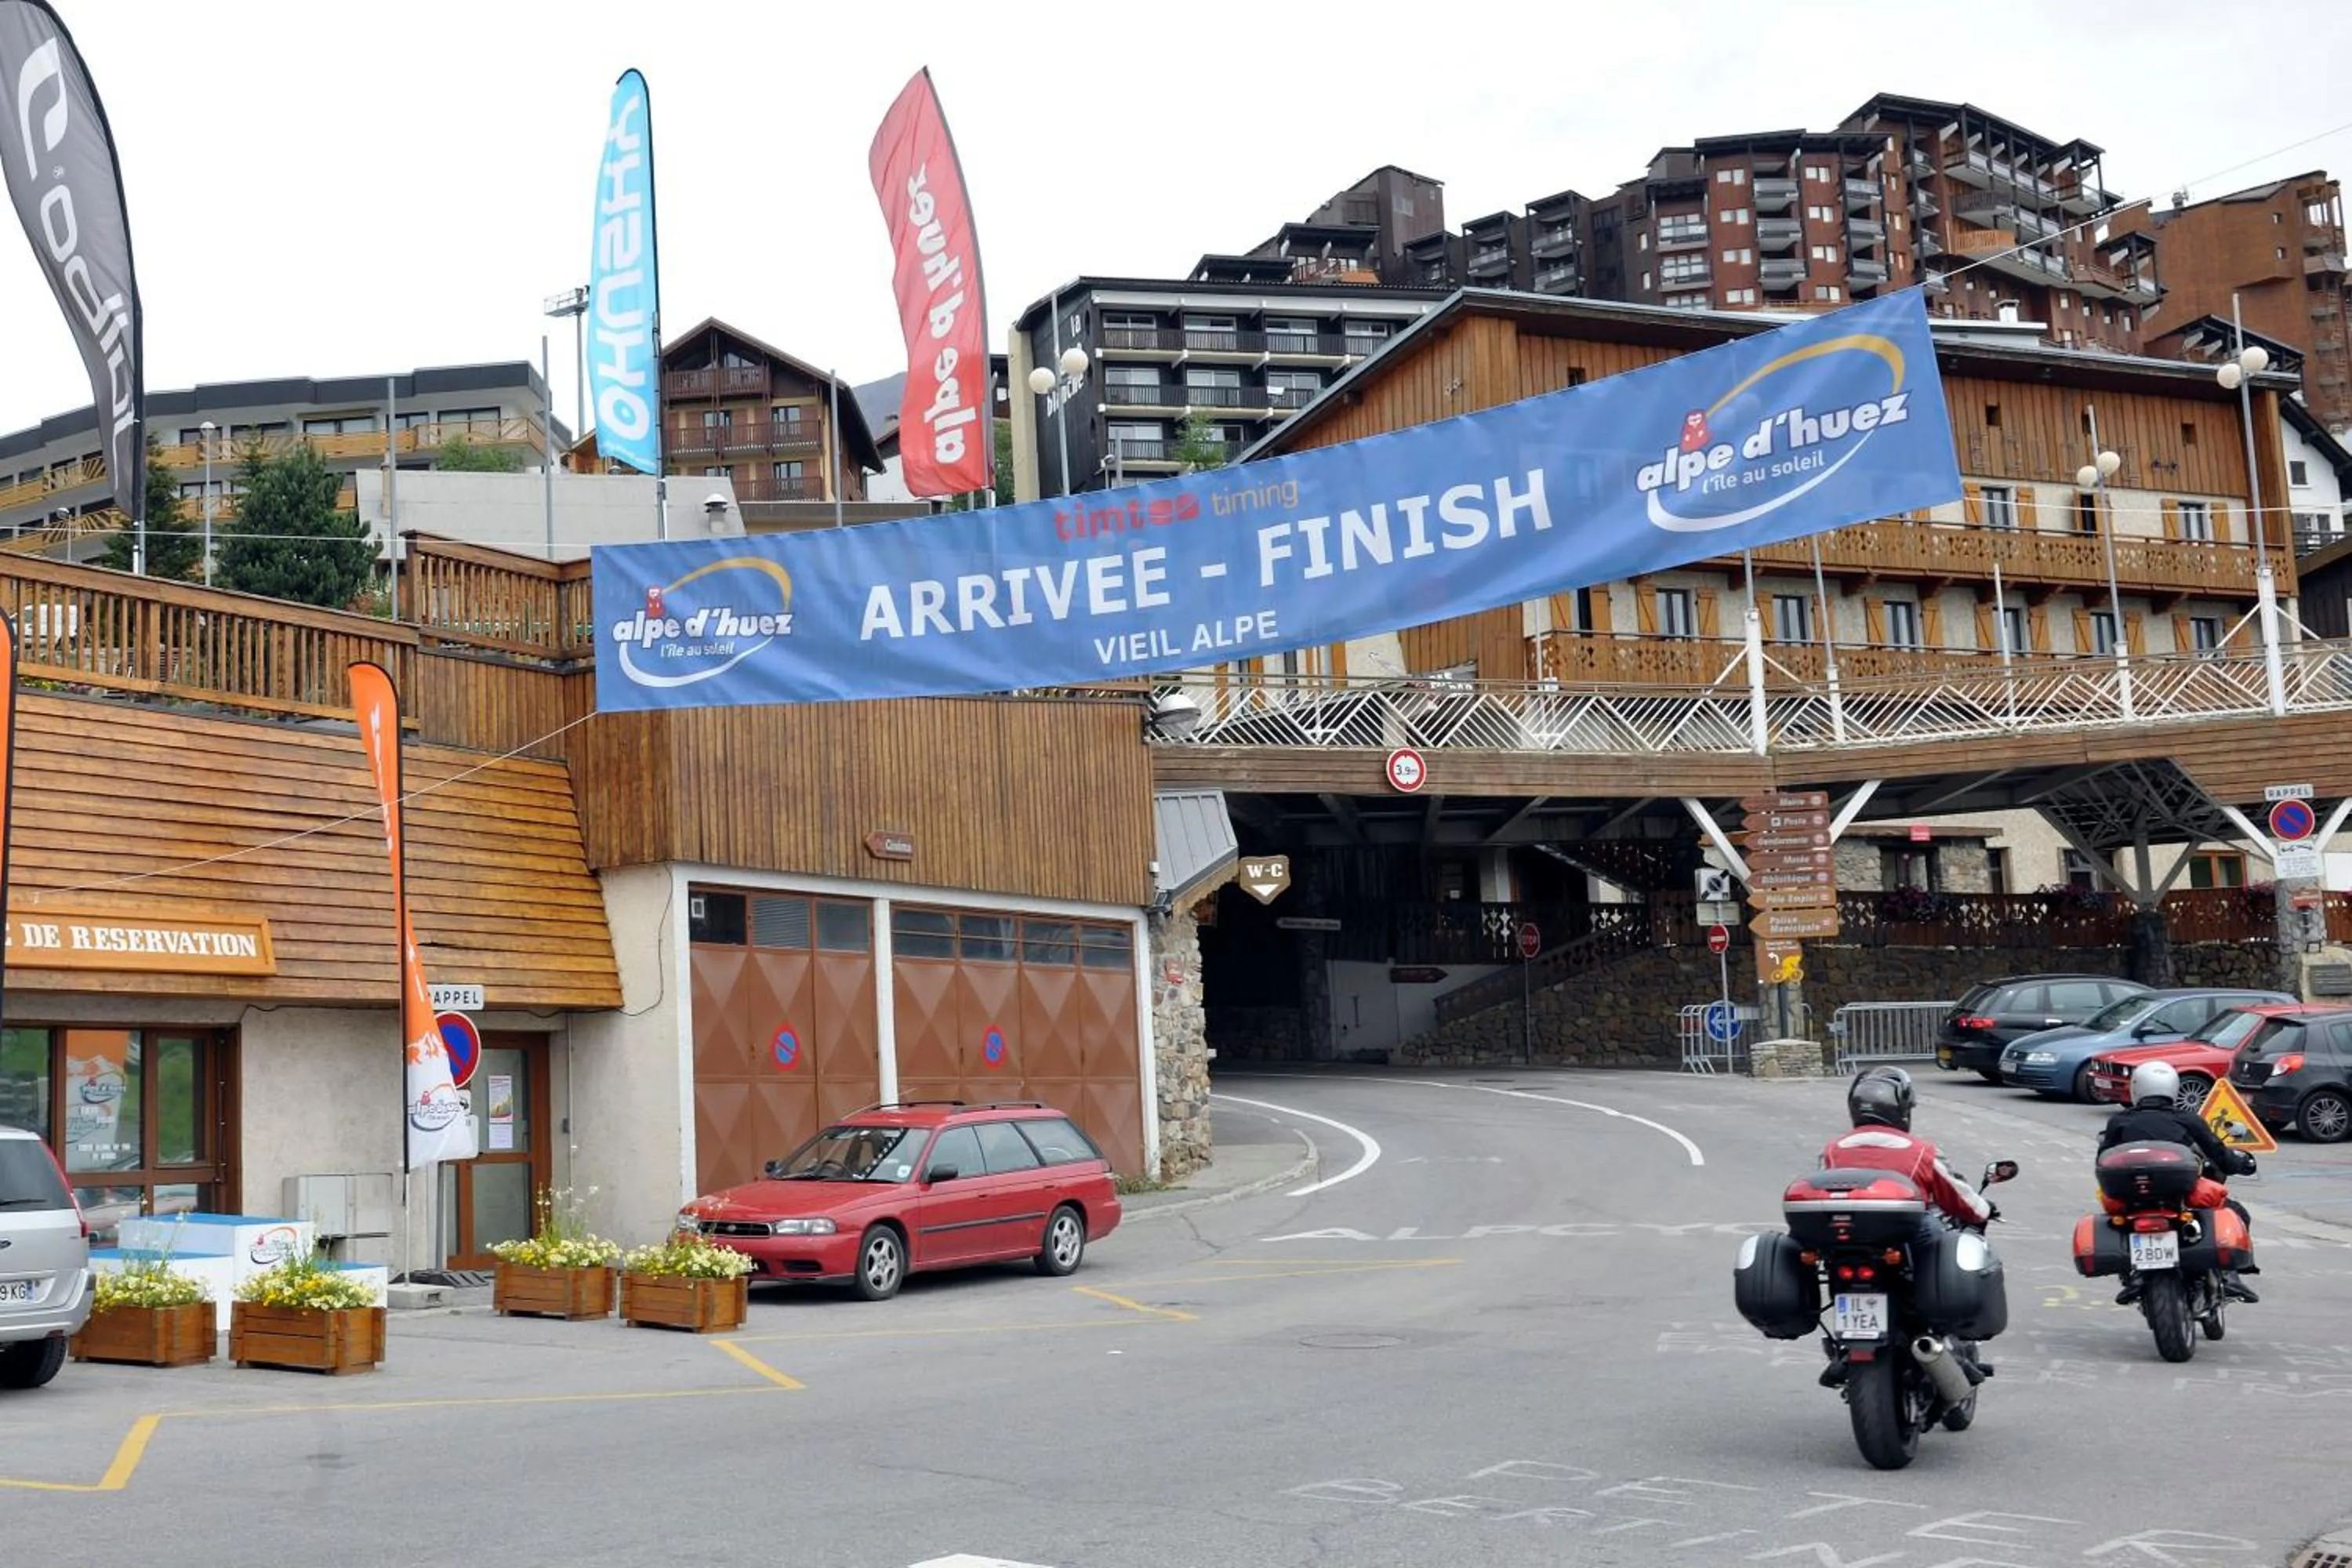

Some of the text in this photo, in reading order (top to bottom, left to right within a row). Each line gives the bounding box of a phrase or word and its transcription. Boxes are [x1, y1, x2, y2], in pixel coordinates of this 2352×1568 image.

[1635, 442, 1736, 494] alpe
[1741, 389, 1913, 459] d'huez
[1742, 464, 1766, 486] au
[1770, 448, 1827, 478] soleil
[1210, 478, 1300, 517] timing
[859, 546, 1171, 641] ARRIVEE
[1258, 468, 1552, 587] FINISH
[612, 607, 793, 649] alpe d'huez
[1094, 610, 1279, 665] VIEIL ALPE
[2268, 788, 2310, 798] RAPPEL
[1769, 916, 1798, 925] Police
[1769, 924, 1820, 934] Municipale
[21, 923, 60, 949] DE
[69, 924, 257, 957] RESERVATION
[427, 990, 479, 1004] APPEL
